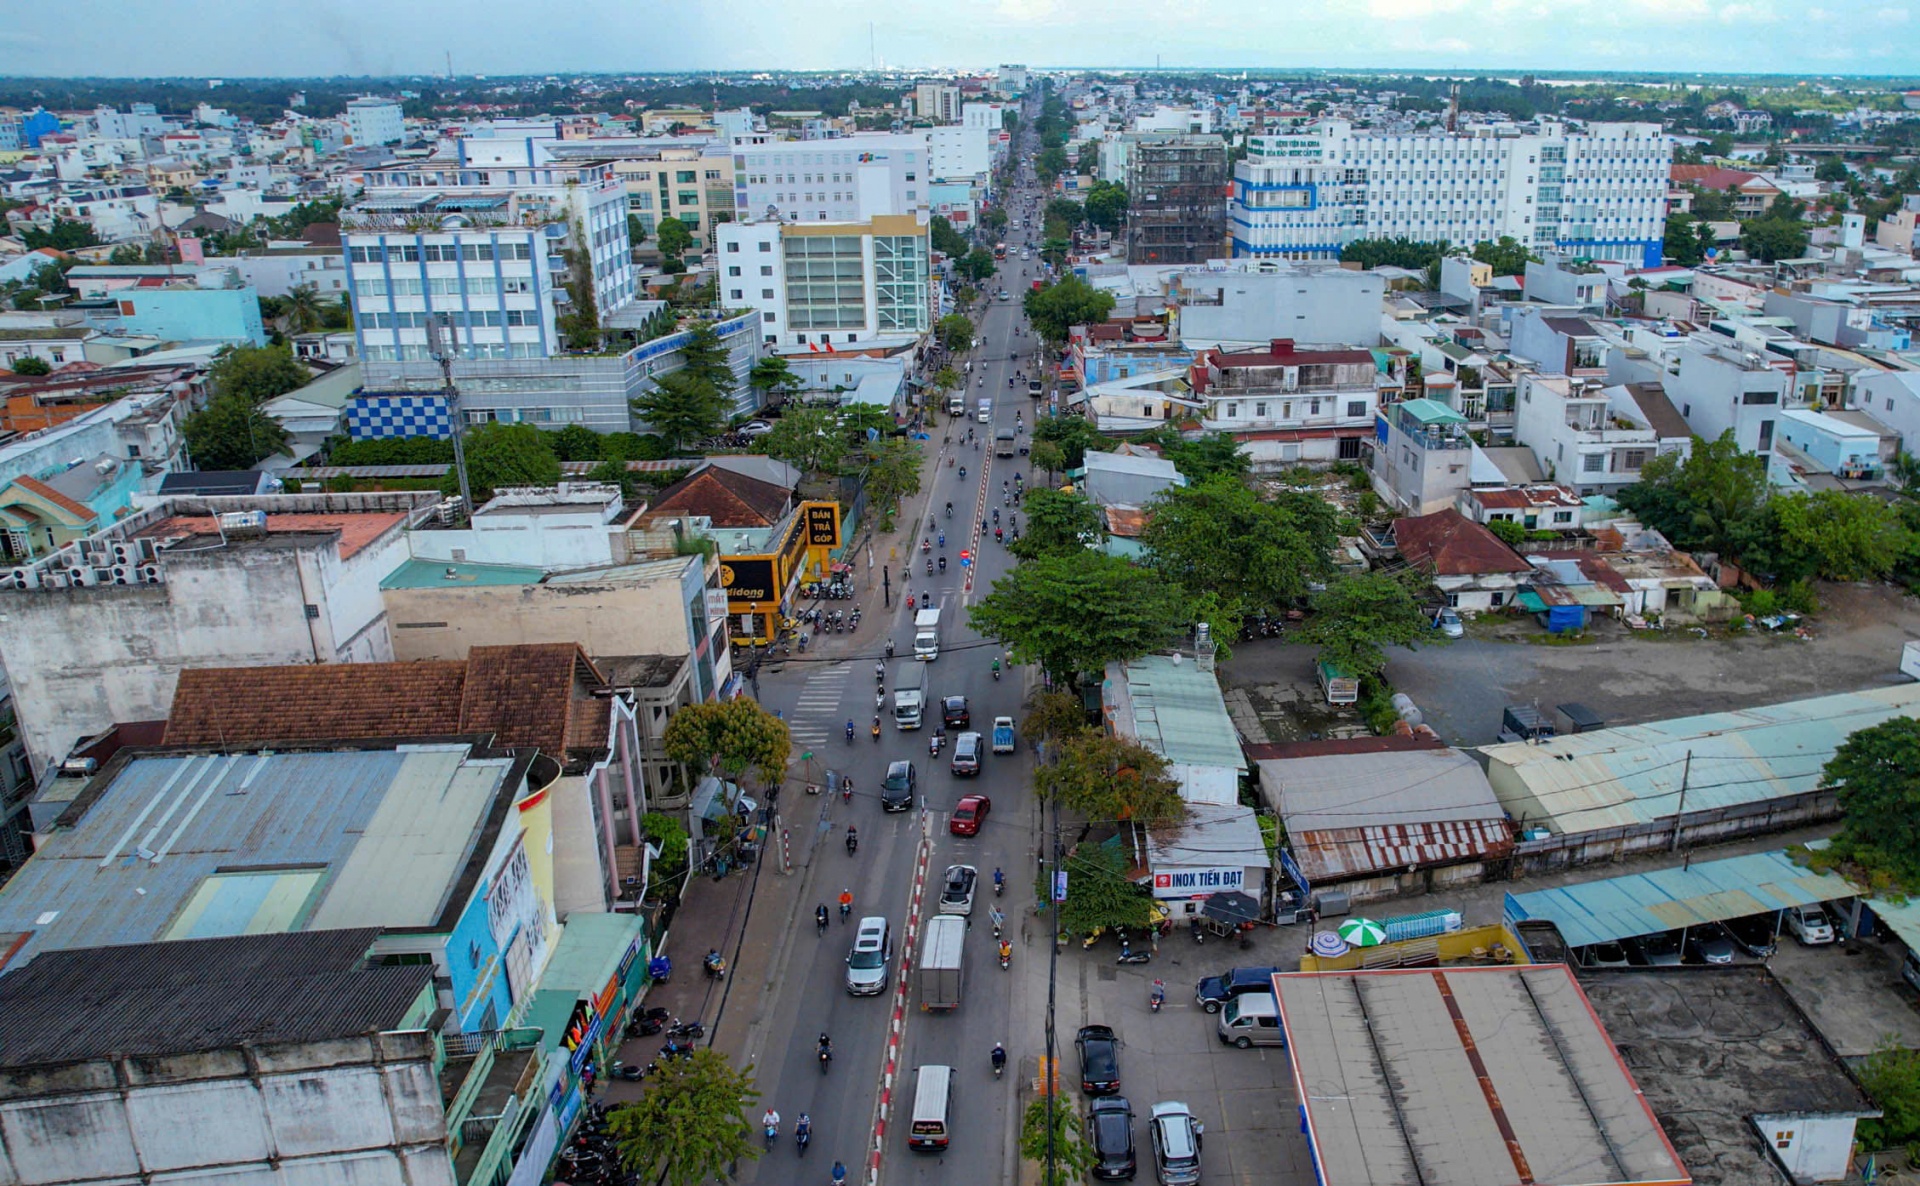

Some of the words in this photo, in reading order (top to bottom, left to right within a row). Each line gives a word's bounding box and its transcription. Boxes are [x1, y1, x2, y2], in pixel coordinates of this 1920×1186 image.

[812, 509, 831, 519] BÁN
[814, 521, 831, 531] TRẢ
[814, 533, 832, 543] GÓP
[1172, 873, 1196, 887] INOX
[1199, 869, 1220, 886] TIẾN
[1223, 871, 1242, 888] ĐẠT
